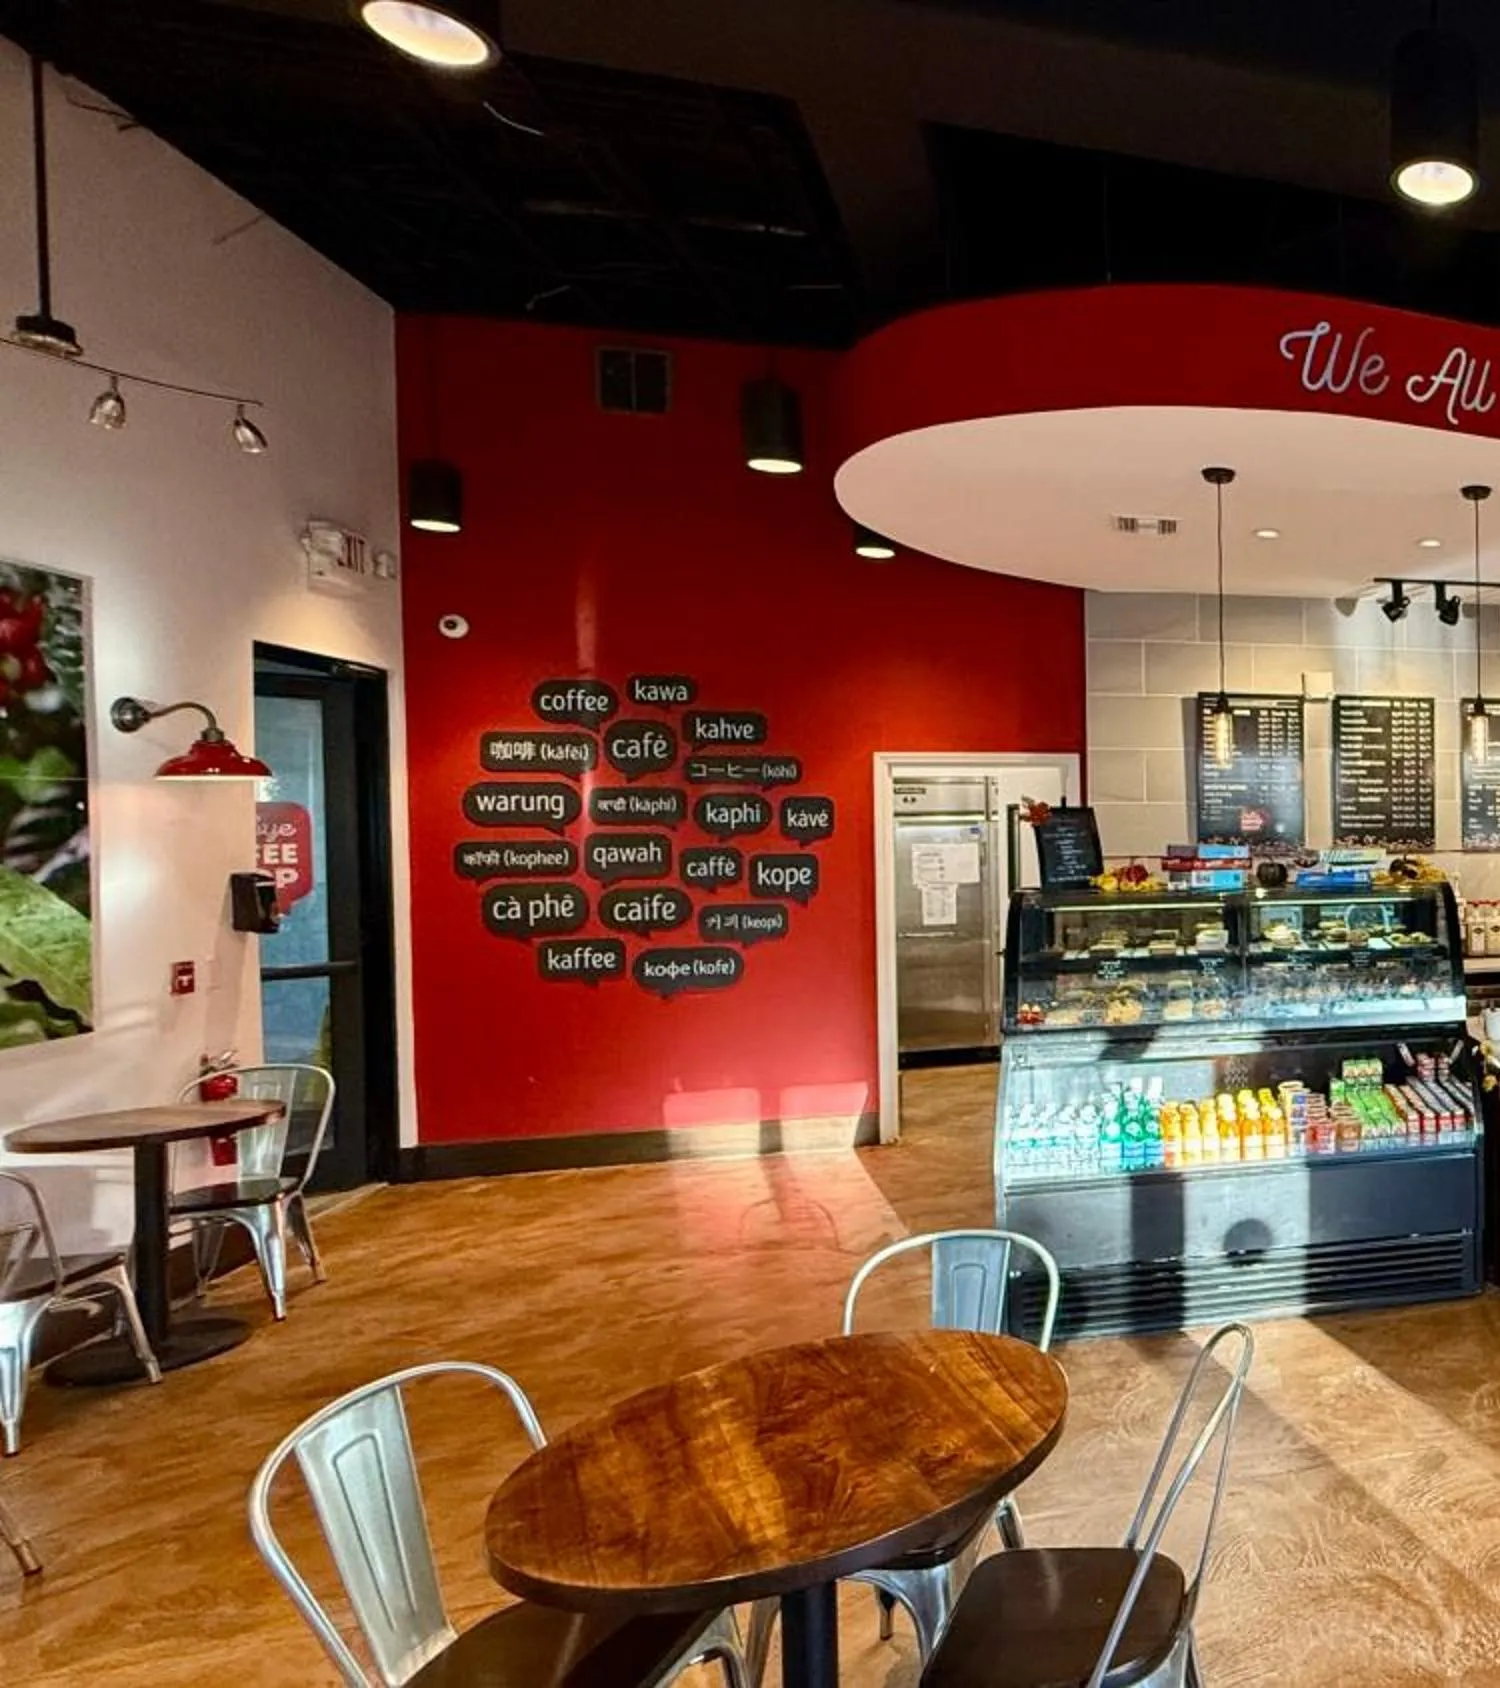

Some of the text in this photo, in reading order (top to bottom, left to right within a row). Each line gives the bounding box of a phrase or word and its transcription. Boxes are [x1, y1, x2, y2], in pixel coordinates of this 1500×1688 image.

[1279, 321, 1390, 395] We
[1406, 347, 1496, 425] All
[540, 689, 609, 711] coffee
[634, 680, 688, 701] kawa
[695, 717, 753, 740] kahve
[612, 731, 668, 758] café
[475, 794, 565, 819] warung
[706, 802, 761, 828] kaphi
[503, 848, 569, 870] (kophee)
[593, 842, 662, 868] qawah
[757, 861, 812, 892] kope
[492, 893, 575, 926] cà phê
[613, 894, 676, 922] caife
[547, 948, 616, 970] kaffee
[693, 958, 735, 976] (kofe)
